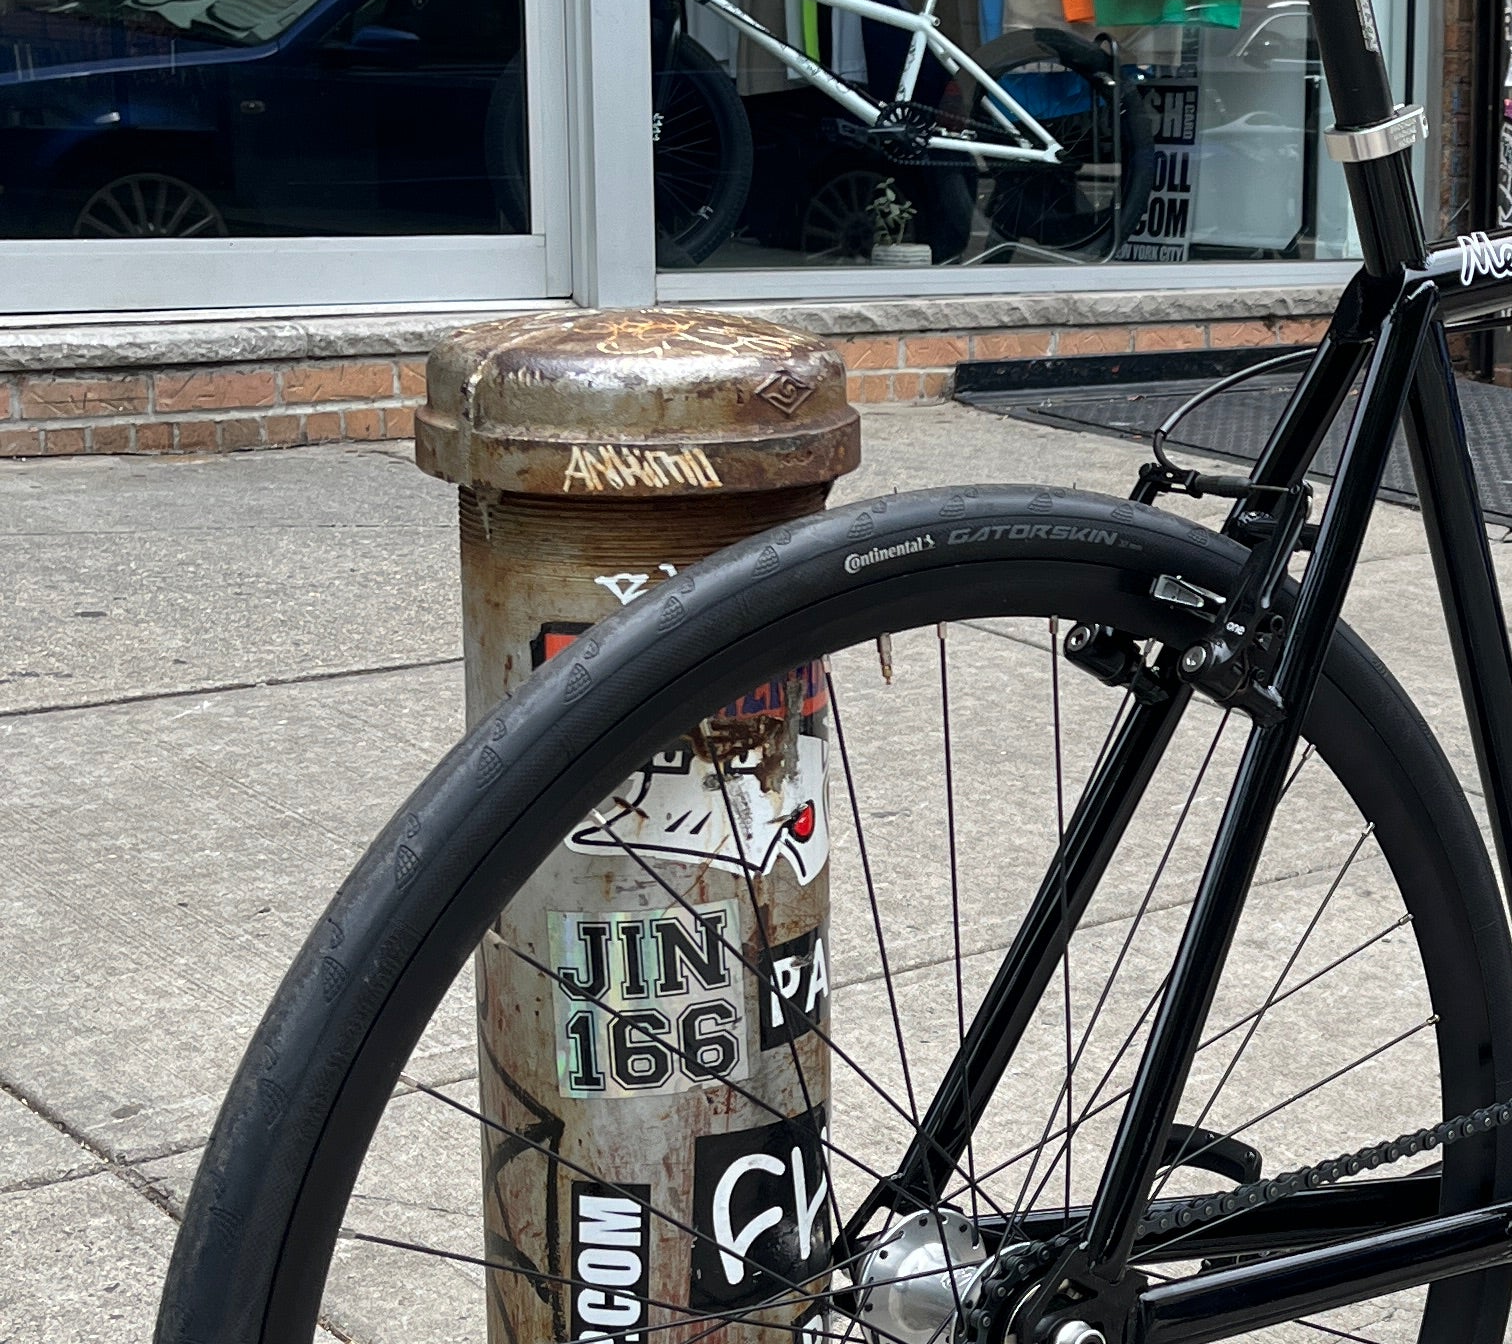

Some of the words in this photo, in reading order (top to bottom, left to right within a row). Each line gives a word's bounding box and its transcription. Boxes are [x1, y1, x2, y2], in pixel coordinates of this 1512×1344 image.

[1132, 244, 1159, 261] YORK
[844, 537, 928, 574] Continental
[948, 522, 1119, 547] GATORSKIN
[558, 908, 731, 999] JIN
[563, 997, 744, 1093] 166
